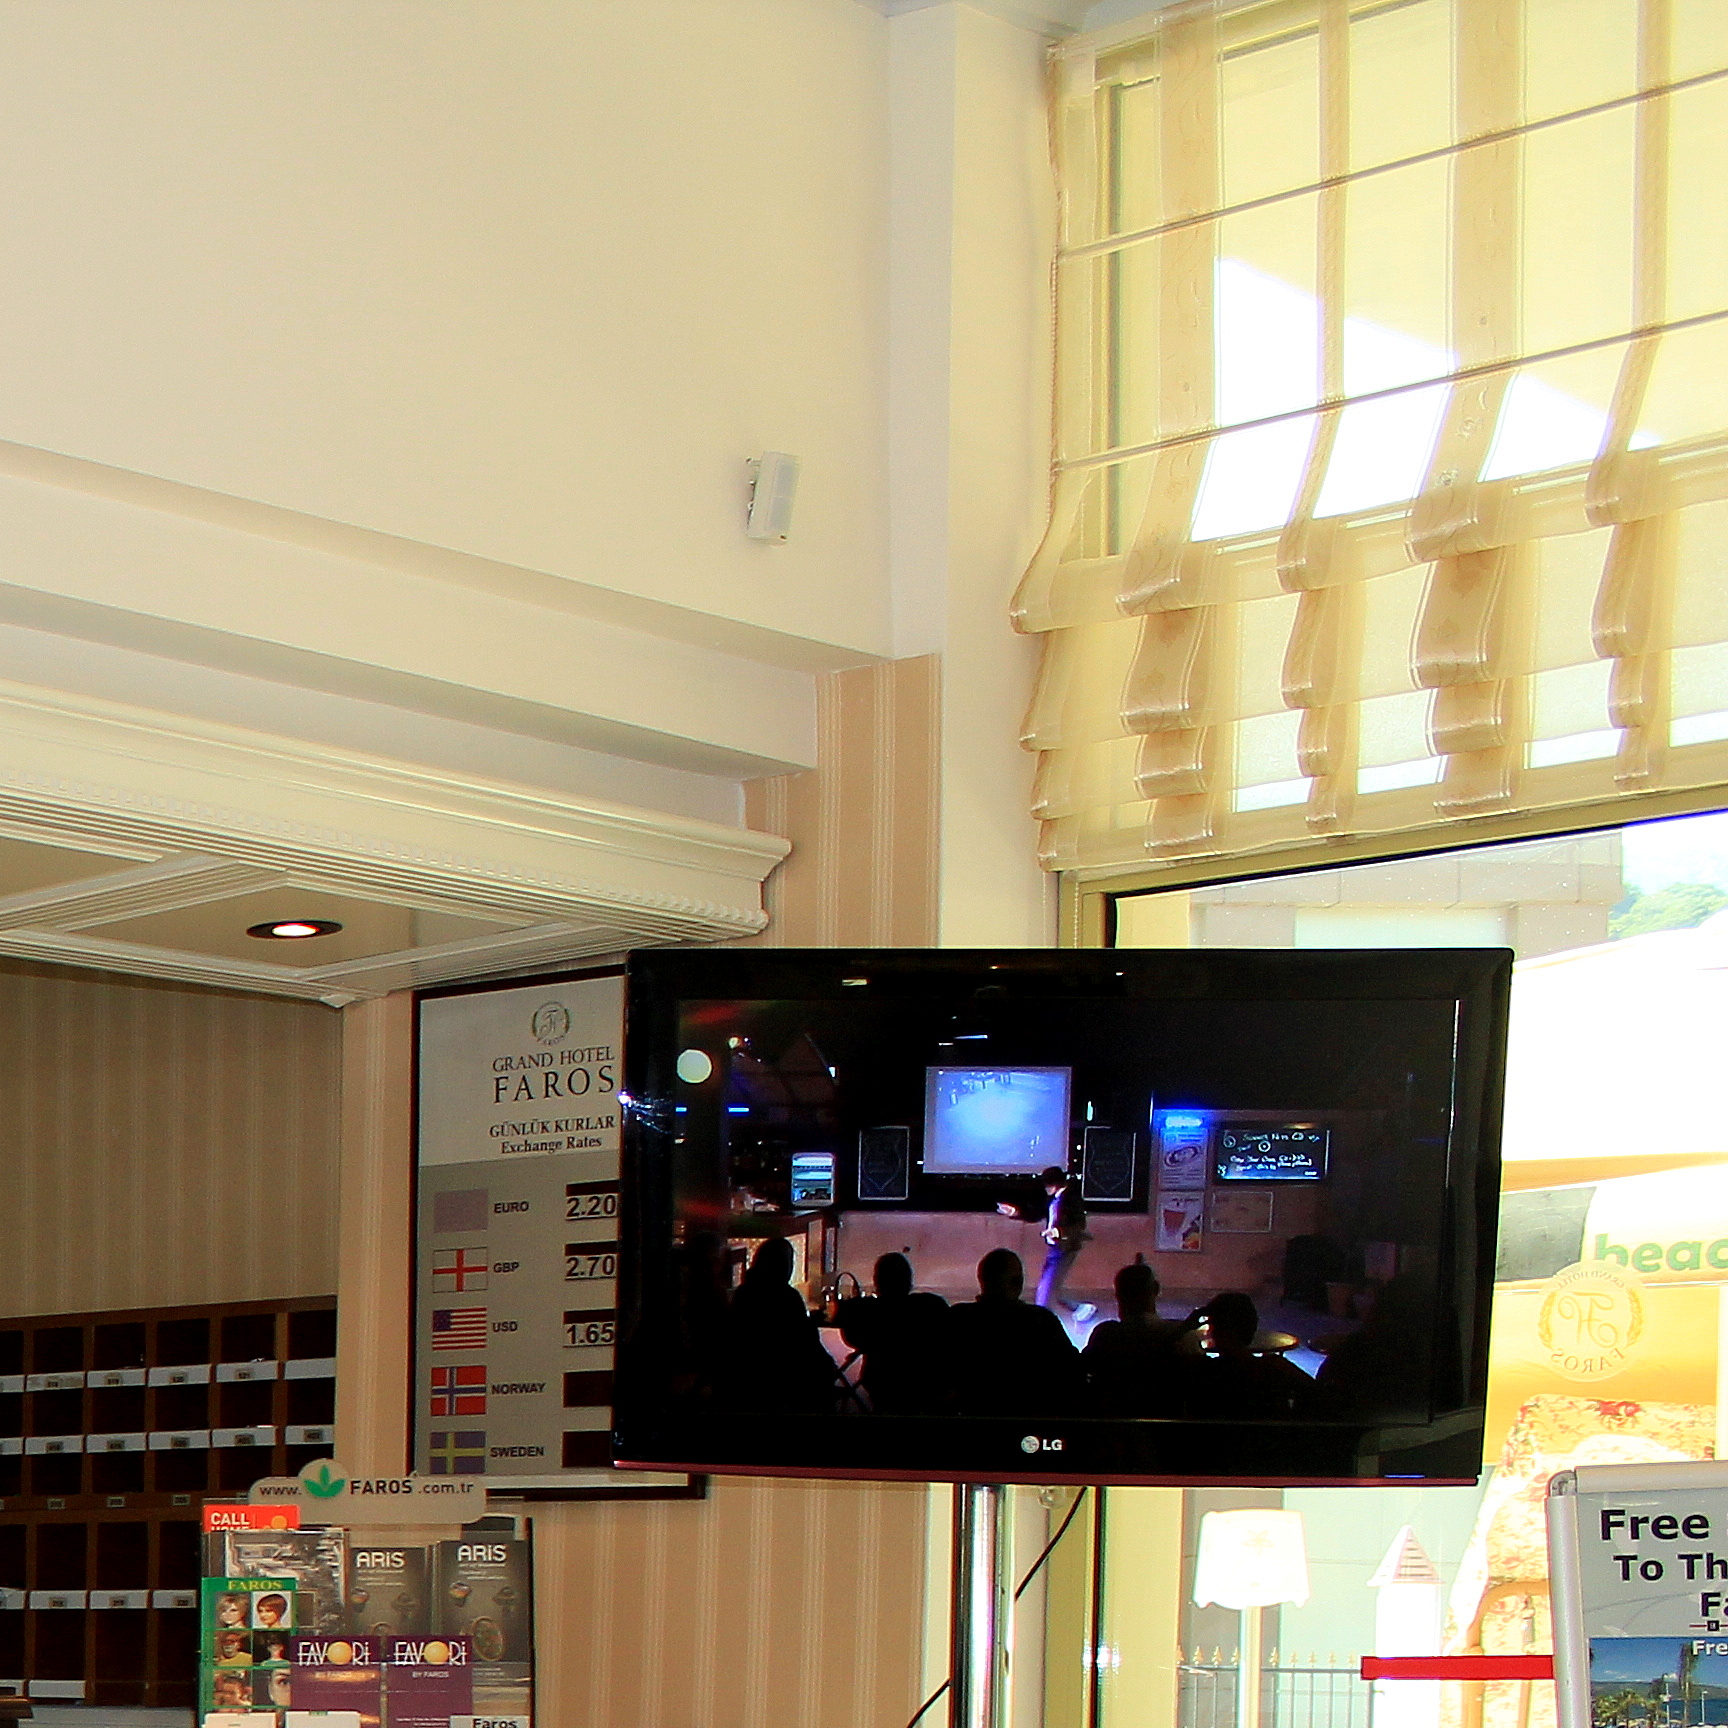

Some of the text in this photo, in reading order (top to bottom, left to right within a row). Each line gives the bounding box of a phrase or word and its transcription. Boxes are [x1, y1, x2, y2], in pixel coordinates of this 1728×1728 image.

[492, 1046, 615, 1073] GRAND HOTEL
[493, 1065, 615, 1104] FAROS
[489, 1115, 615, 1138] GÜNLÜK KURLAR
[501, 1136, 602, 1155] Exchange Rates
[493, 1194, 617, 1217] EURO 2.20
[493, 1255, 615, 1277] GBP 2.70
[492, 1321, 614, 1345] USD 1.65
[491, 1382, 546, 1396] NORWAY
[490, 1446, 545, 1458] SWEDEN
[1042, 1439, 1063, 1450] LG
[259, 1479, 474, 1497] www. FAROS .com.tr
[210, 1512, 251, 1525] CALL
[1600, 1508, 1710, 1541] Free
[1612, 1552, 1728, 1581] To Th
[227, 1579, 284, 1591] FAROS
[412, 1670, 449, 1679] BY FAROS
